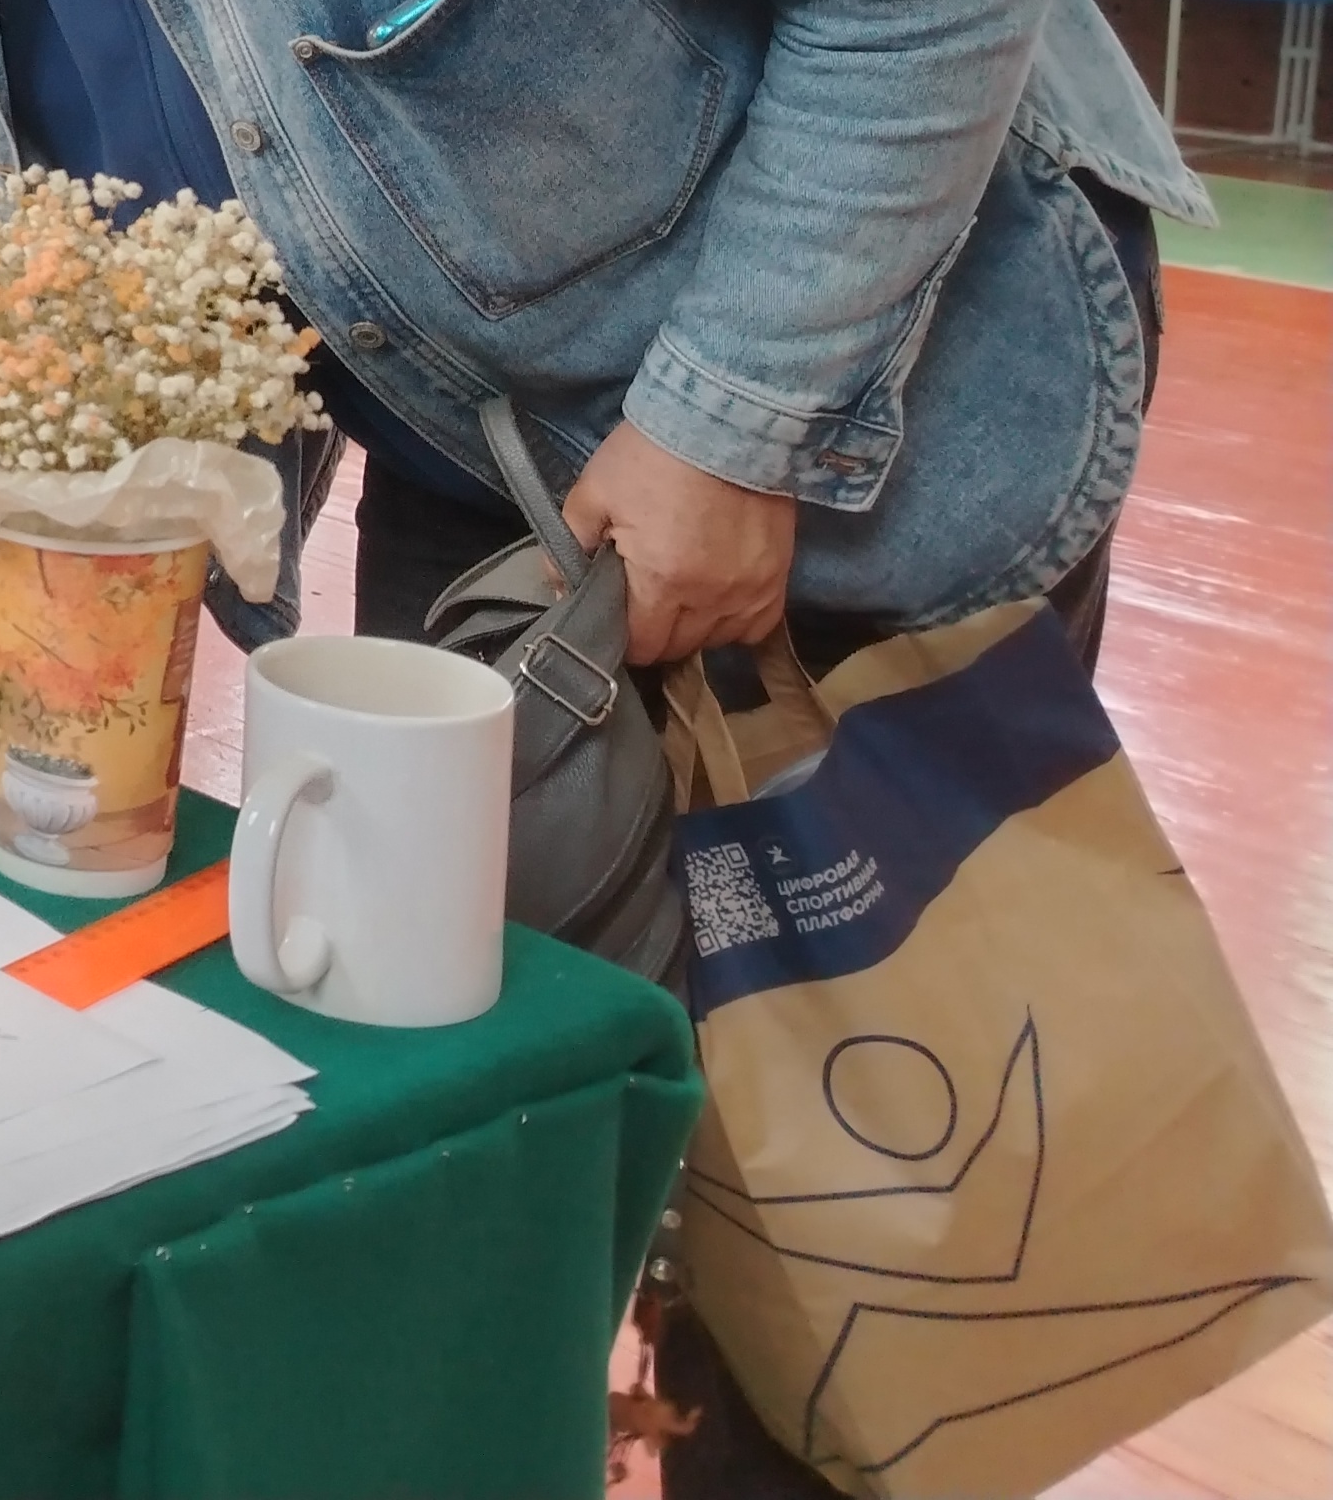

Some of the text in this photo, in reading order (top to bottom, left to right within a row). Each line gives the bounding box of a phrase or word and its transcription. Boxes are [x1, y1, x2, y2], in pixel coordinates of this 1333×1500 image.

[776, 849, 860, 897] ЦИФРОВАЯ
[786, 856, 878, 914] СПОРТИВНАЯ
[795, 880, 885, 934] ПЛАТФОРМА
